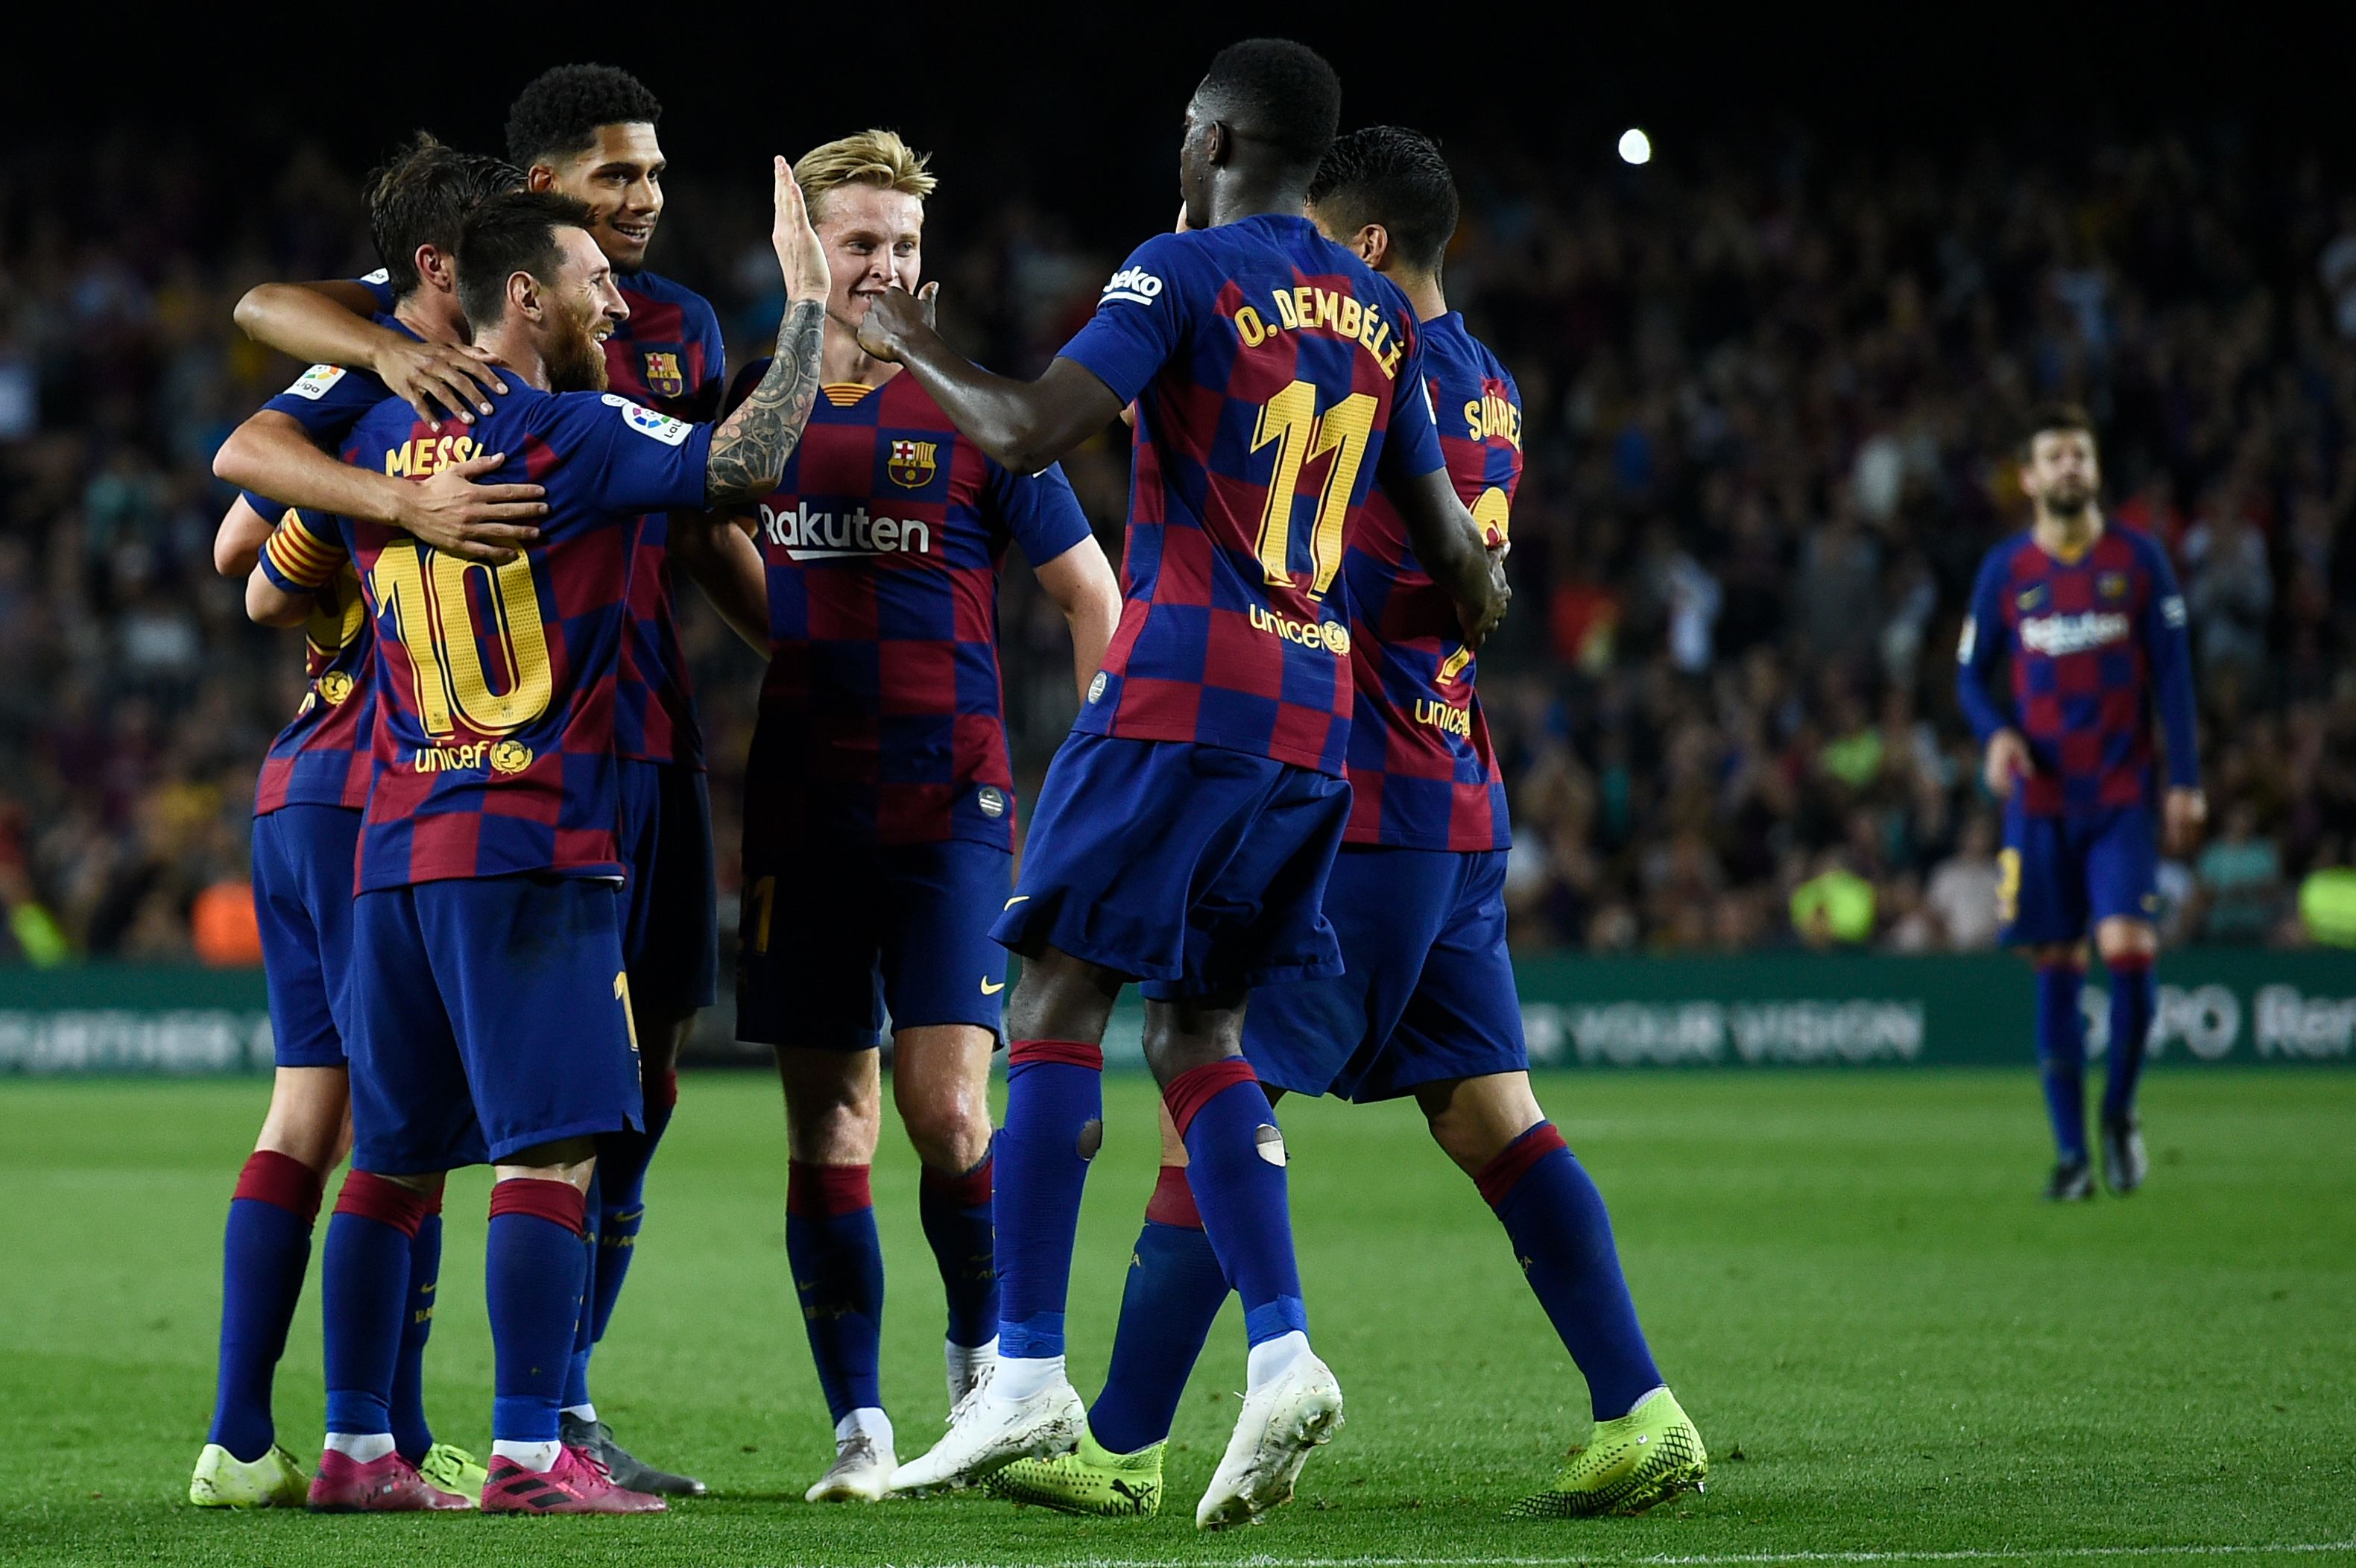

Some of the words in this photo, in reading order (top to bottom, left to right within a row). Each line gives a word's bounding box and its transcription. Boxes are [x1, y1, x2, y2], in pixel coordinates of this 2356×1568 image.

[1234, 306, 1278, 347] O.
[1250, 380, 1379, 601] 11
[759, 502, 929, 553] Rakuten
[368, 537, 552, 740] 10
[1249, 603, 1326, 651] unice
[1415, 698, 1465, 736] unice
[414, 740, 490, 774] unicef
